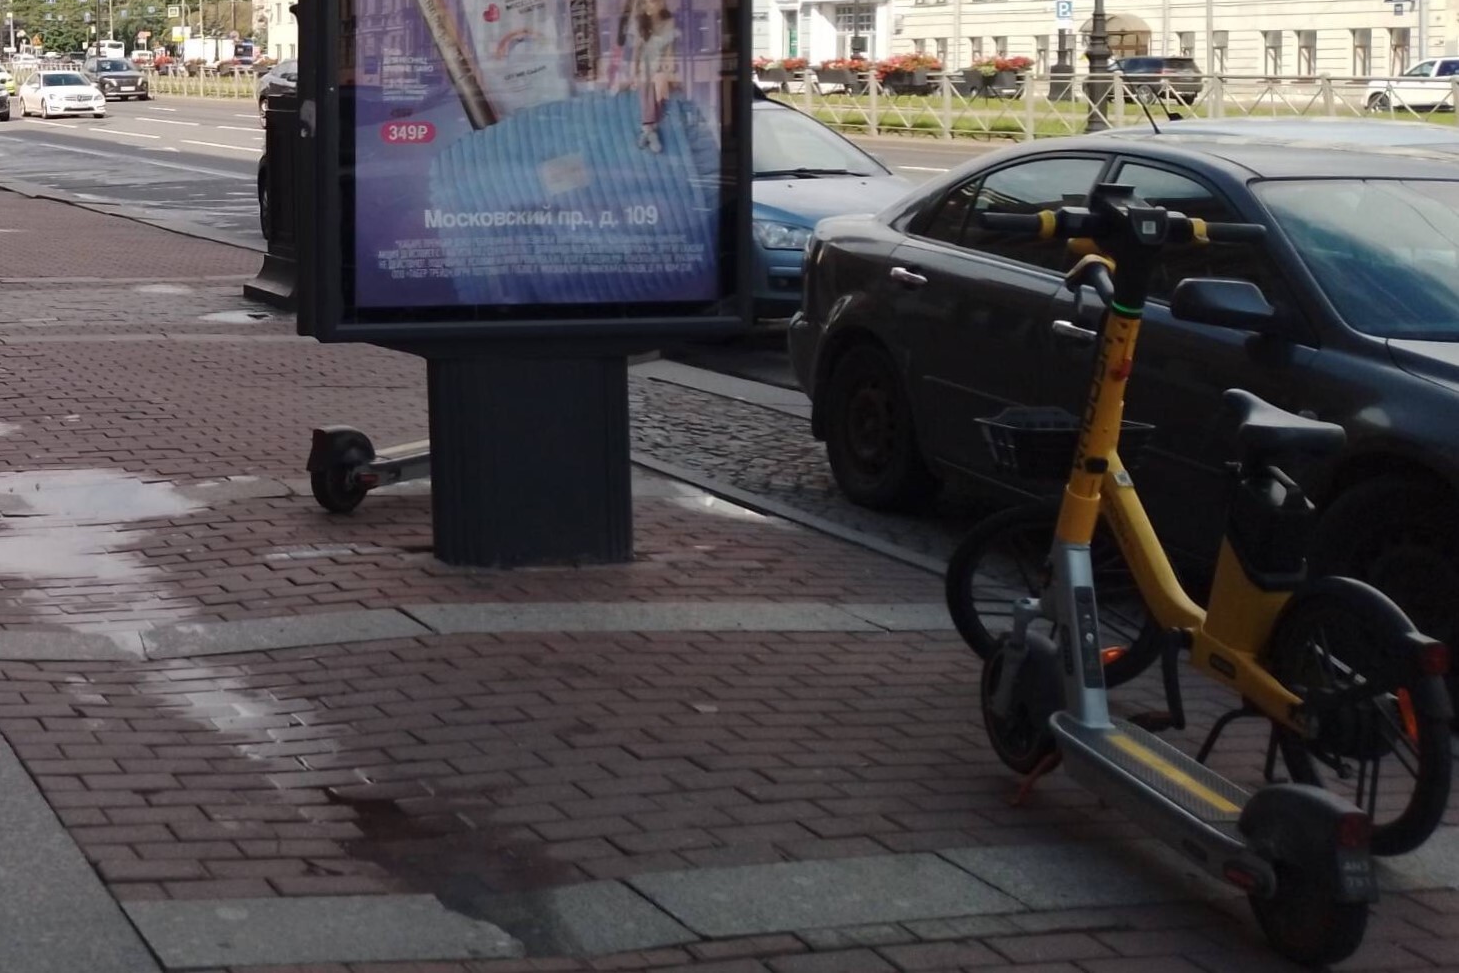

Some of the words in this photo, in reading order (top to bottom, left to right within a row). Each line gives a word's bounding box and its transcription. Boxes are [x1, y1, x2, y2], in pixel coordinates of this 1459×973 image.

[389, 125, 428, 140] 349₽
[424, 205, 553, 228] Московский
[557, 210, 593, 230] пр.,
[599, 209, 619, 226] д.
[628, 206, 658, 225] 109
